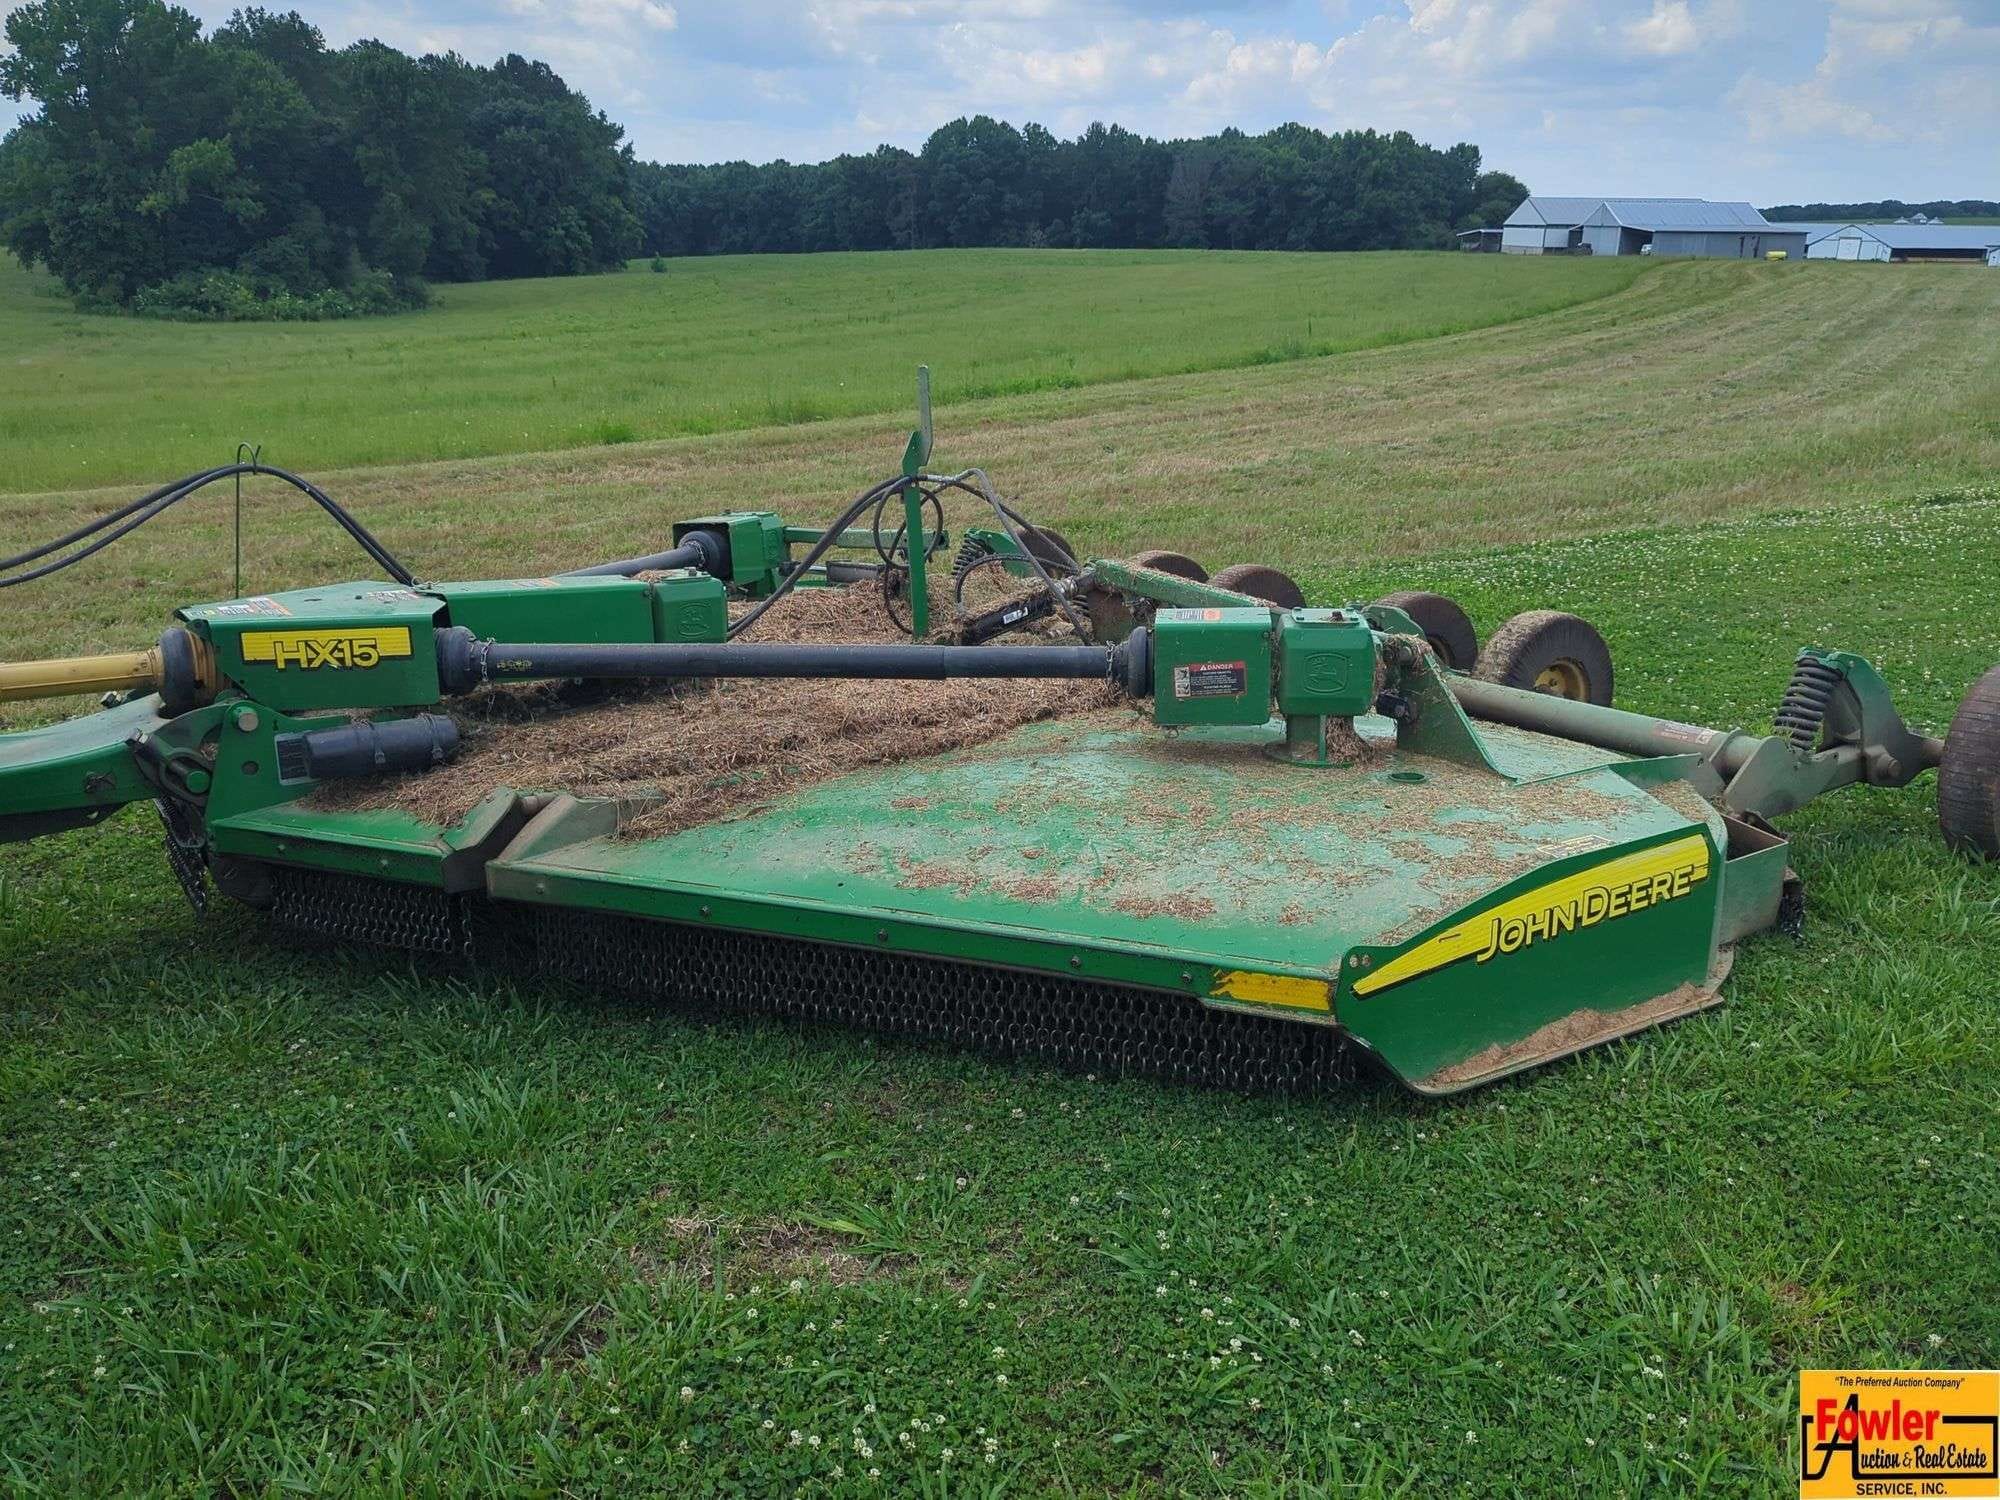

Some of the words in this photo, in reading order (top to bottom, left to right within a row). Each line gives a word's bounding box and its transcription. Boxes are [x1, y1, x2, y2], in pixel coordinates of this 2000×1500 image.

[274, 638, 380, 670] HX15
[1477, 900, 1577, 963] JOHN
[1581, 864, 1694, 927] DEERE
